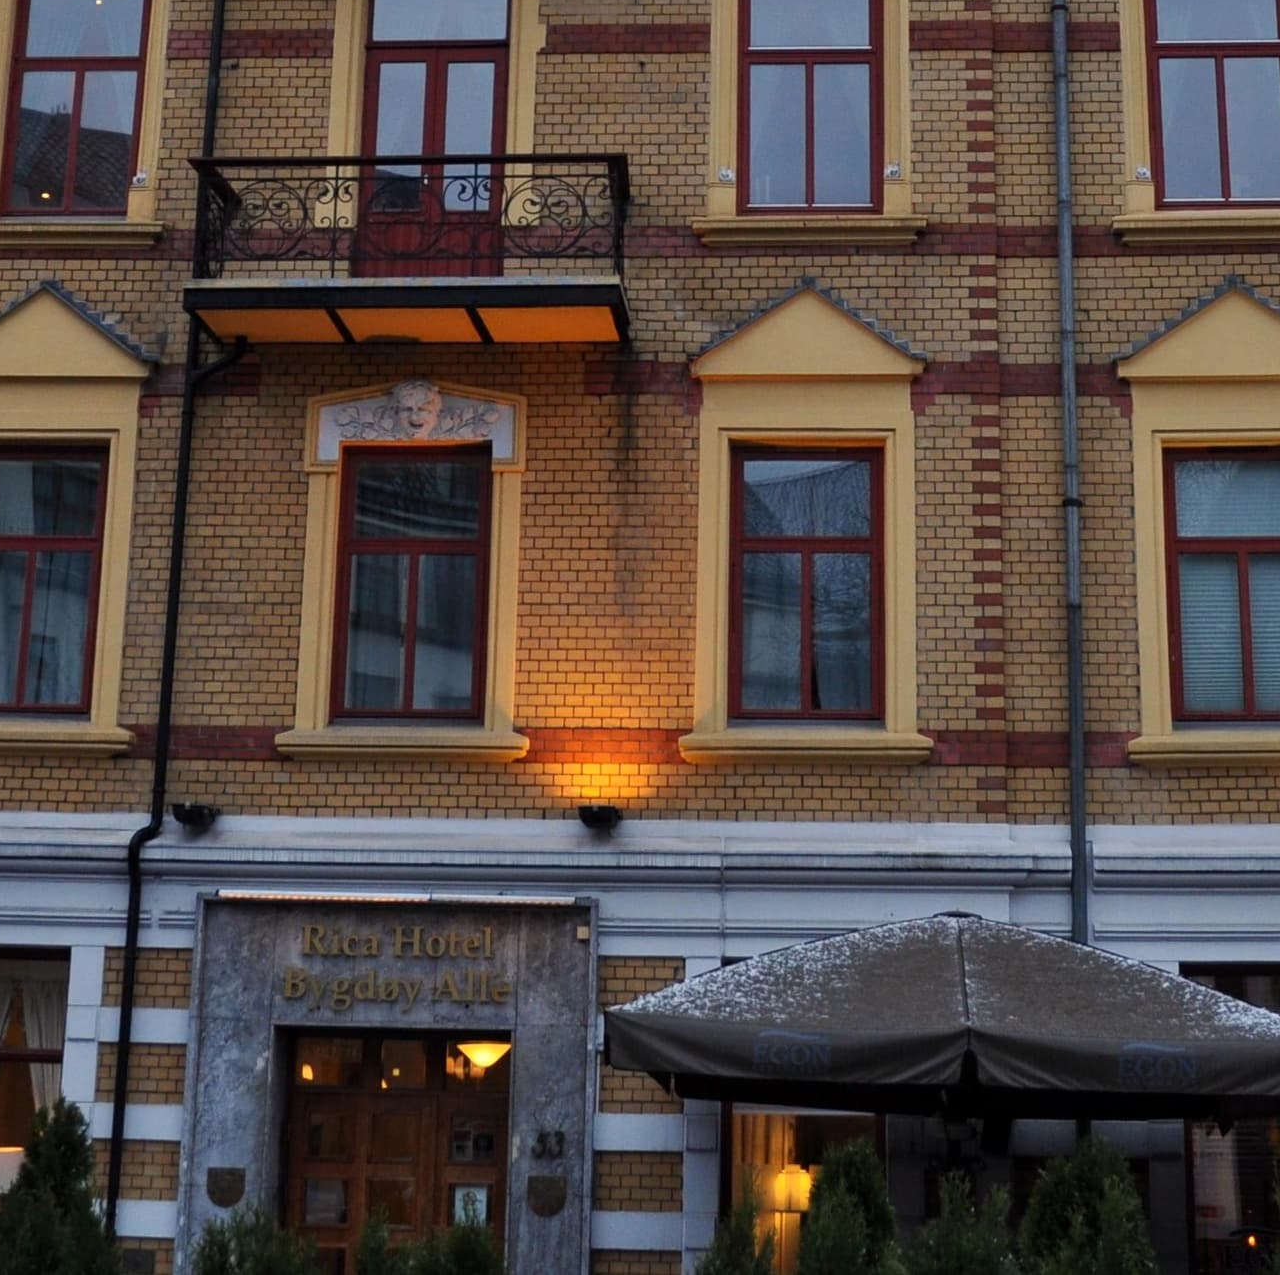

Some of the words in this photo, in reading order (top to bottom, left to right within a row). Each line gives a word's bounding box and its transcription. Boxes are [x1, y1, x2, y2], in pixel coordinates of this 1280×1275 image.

[302, 924, 380, 957] Rica
[391, 924, 495, 959] Hotel
[283, 967, 422, 1015] Bygdøy
[752, 1042, 832, 1065] EGON
